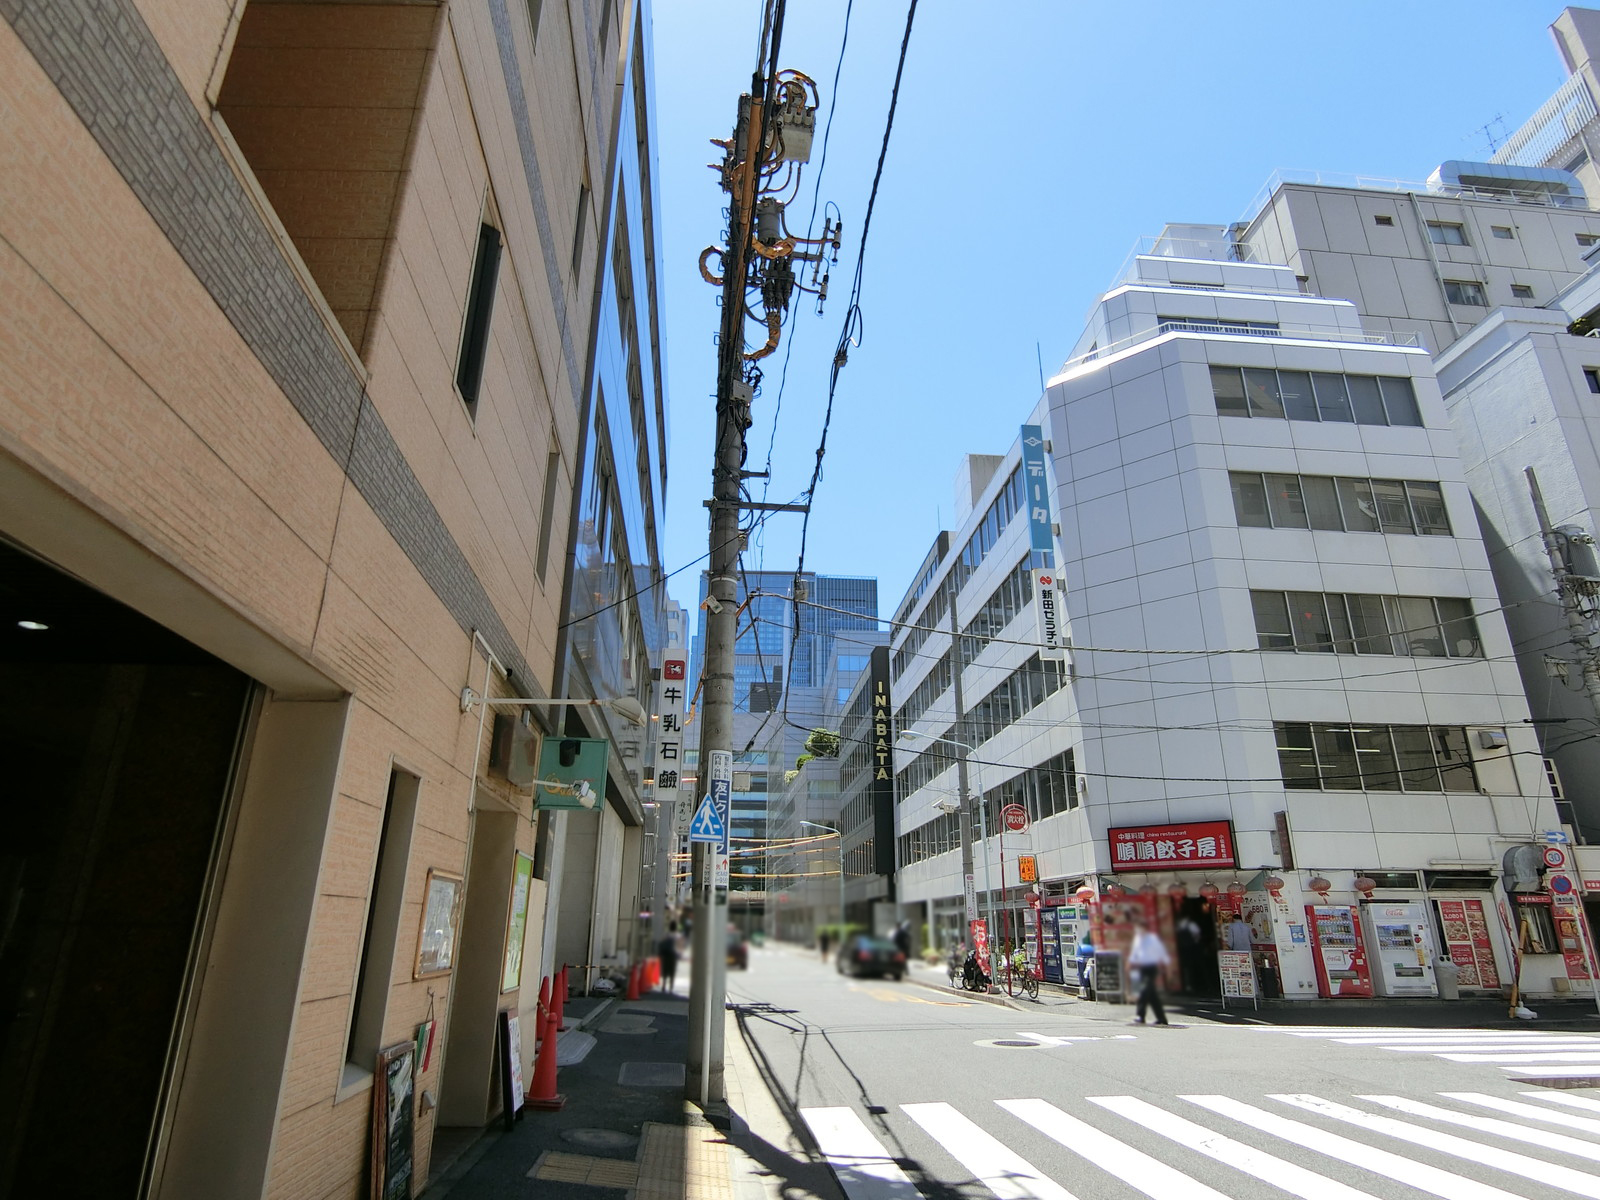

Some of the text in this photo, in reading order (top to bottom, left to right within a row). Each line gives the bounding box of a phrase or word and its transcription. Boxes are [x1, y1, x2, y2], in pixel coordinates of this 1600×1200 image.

[1028, 461, 1048, 524] データ
[1041, 589, 1057, 650] 新田ゼラチン
[875, 681, 889, 780] INABATA
[1116, 837, 1217, 861] 順順餃子房
[1548, 853, 1560, 862] 30
